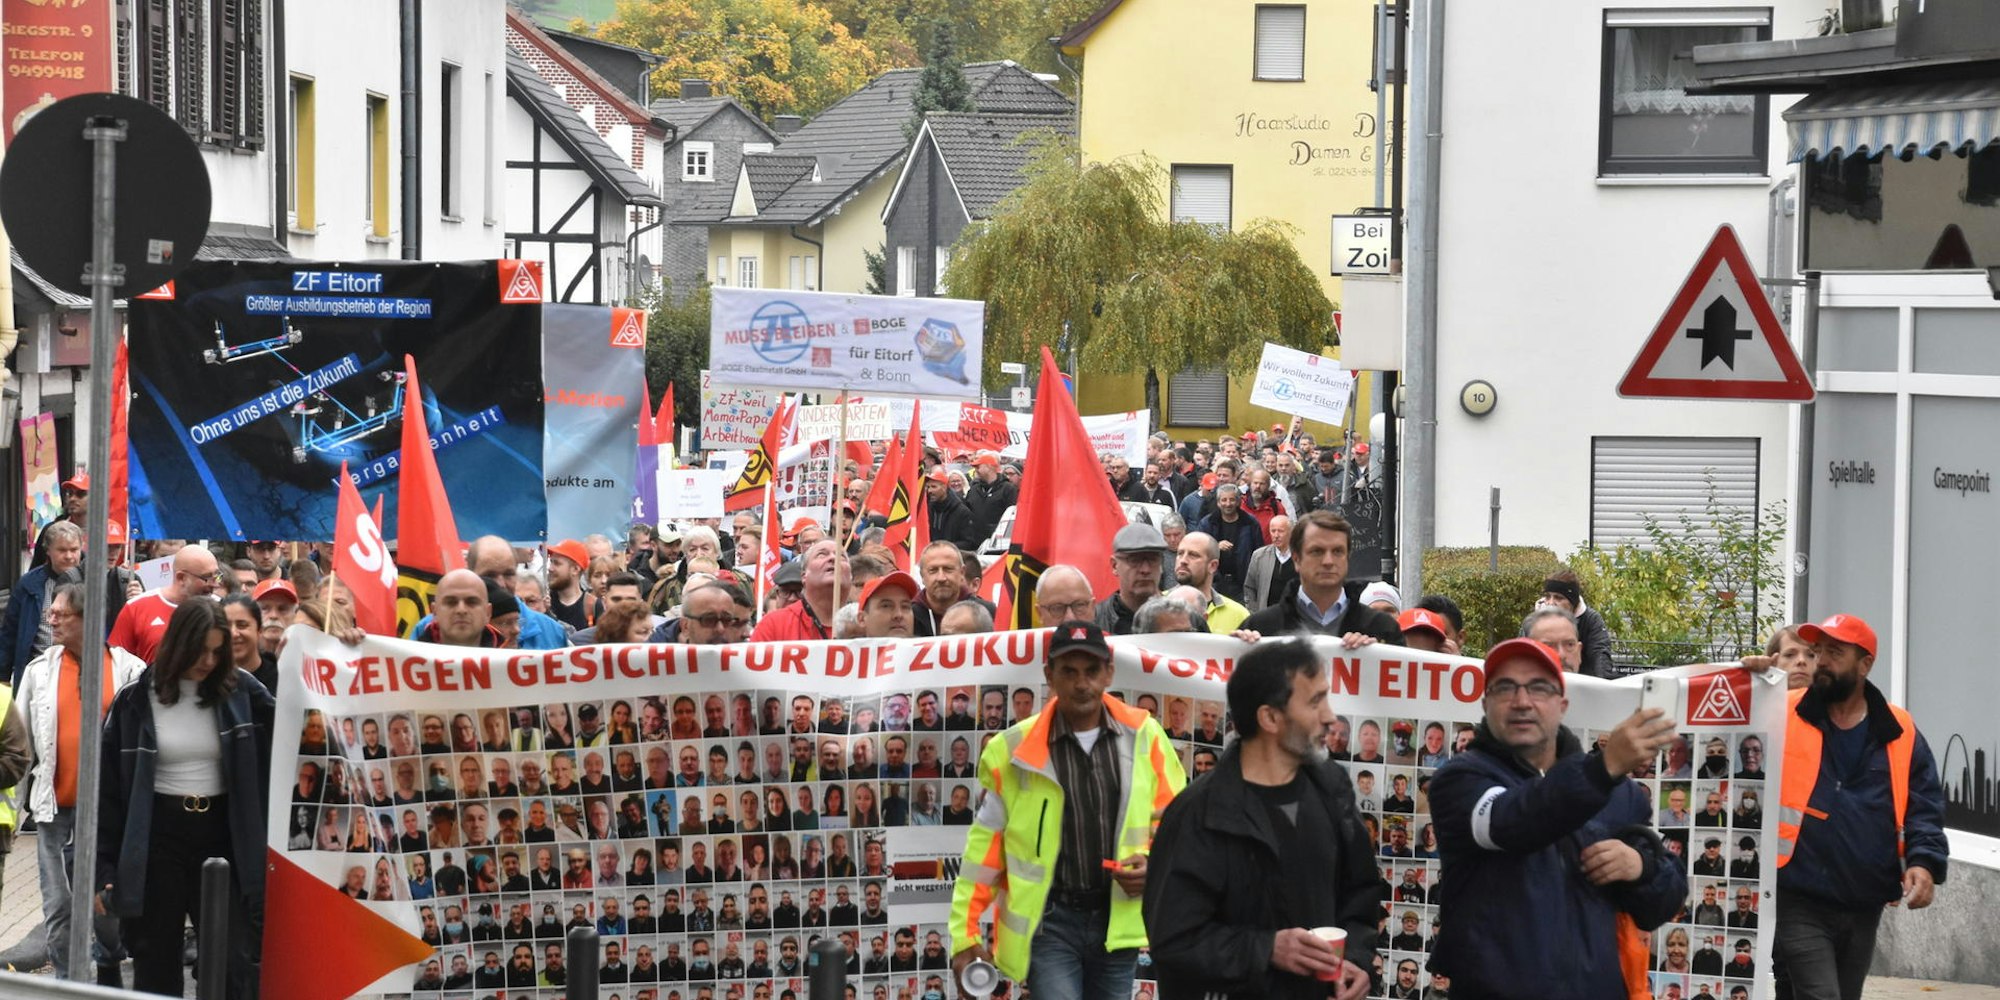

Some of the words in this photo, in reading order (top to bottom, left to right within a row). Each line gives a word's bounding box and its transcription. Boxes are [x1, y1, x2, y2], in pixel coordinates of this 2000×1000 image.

[2, 23, 76, 36] SIEGSTR.
[81, 24, 93, 37] 9
[9, 48, 85, 61] TELEFON
[9, 65, 85, 79] 9499418
[1235, 112, 1331, 137] Haarstudio
[1289, 141, 1350, 166] Damen
[1353, 223, 1384, 238] Bei
[1347, 248, 1388, 268] Zoi
[293, 271, 322, 292] ZF
[328, 272, 382, 293] Eitorf
[246, 295, 283, 312] Größter
[285, 296, 376, 316] Ausbildungsbetrieb
[378, 299, 394, 314] der
[396, 300, 432, 318] Region
[724, 328, 769, 345] MUSS
[775, 323, 836, 342] BLEIBEN
[871, 316, 907, 330] BOGE
[849, 346, 870, 359] für
[874, 348, 914, 361] Eitorf
[860, 367, 873, 380] &
[877, 368, 912, 382] Bonn
[1262, 359, 1279, 374] Wir
[1281, 366, 1313, 382] wollen
[1313, 374, 1350, 392] Zukunft
[190, 418, 232, 444] Ohne
[233, 406, 261, 427] uns
[259, 396, 281, 414] ist
[281, 385, 304, 405] die
[302, 356, 358, 395] Zukunft
[1294, 389, 1312, 402] und
[1314, 394, 1344, 409] Eitorf!
[1473, 393, 1486, 403] 10
[593, 478, 615, 489] am
[1829, 460, 1876, 488] Spielhalle
[1933, 466, 1990, 498] Gamepoint
[348, 656, 493, 697] ZEIGEN
[507, 645, 699, 688] GESICHT
[824, 643, 898, 679] DIE
[1136, 648, 1233, 683] VON
[894, 883, 914, 892] nicht
